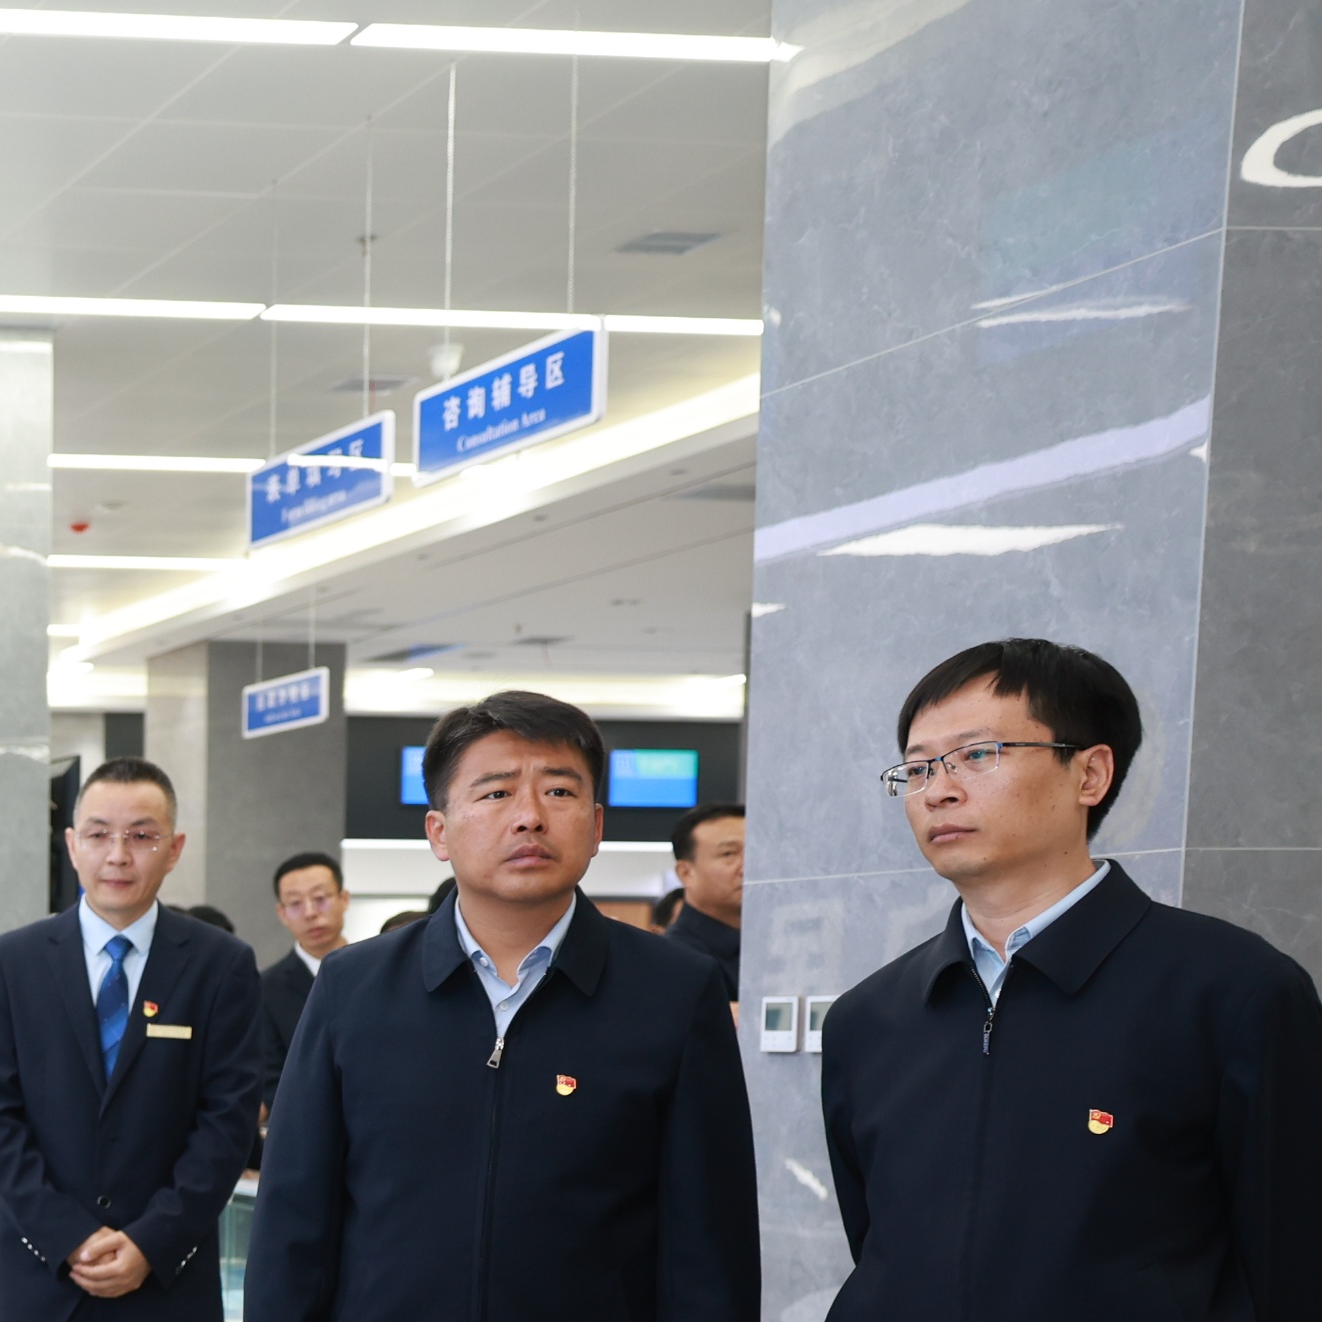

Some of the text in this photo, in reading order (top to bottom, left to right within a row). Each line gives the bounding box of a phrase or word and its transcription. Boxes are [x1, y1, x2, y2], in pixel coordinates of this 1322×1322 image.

[442, 350, 565, 432] 咨询辅导区
[457, 408, 547, 452] Consultation Area
